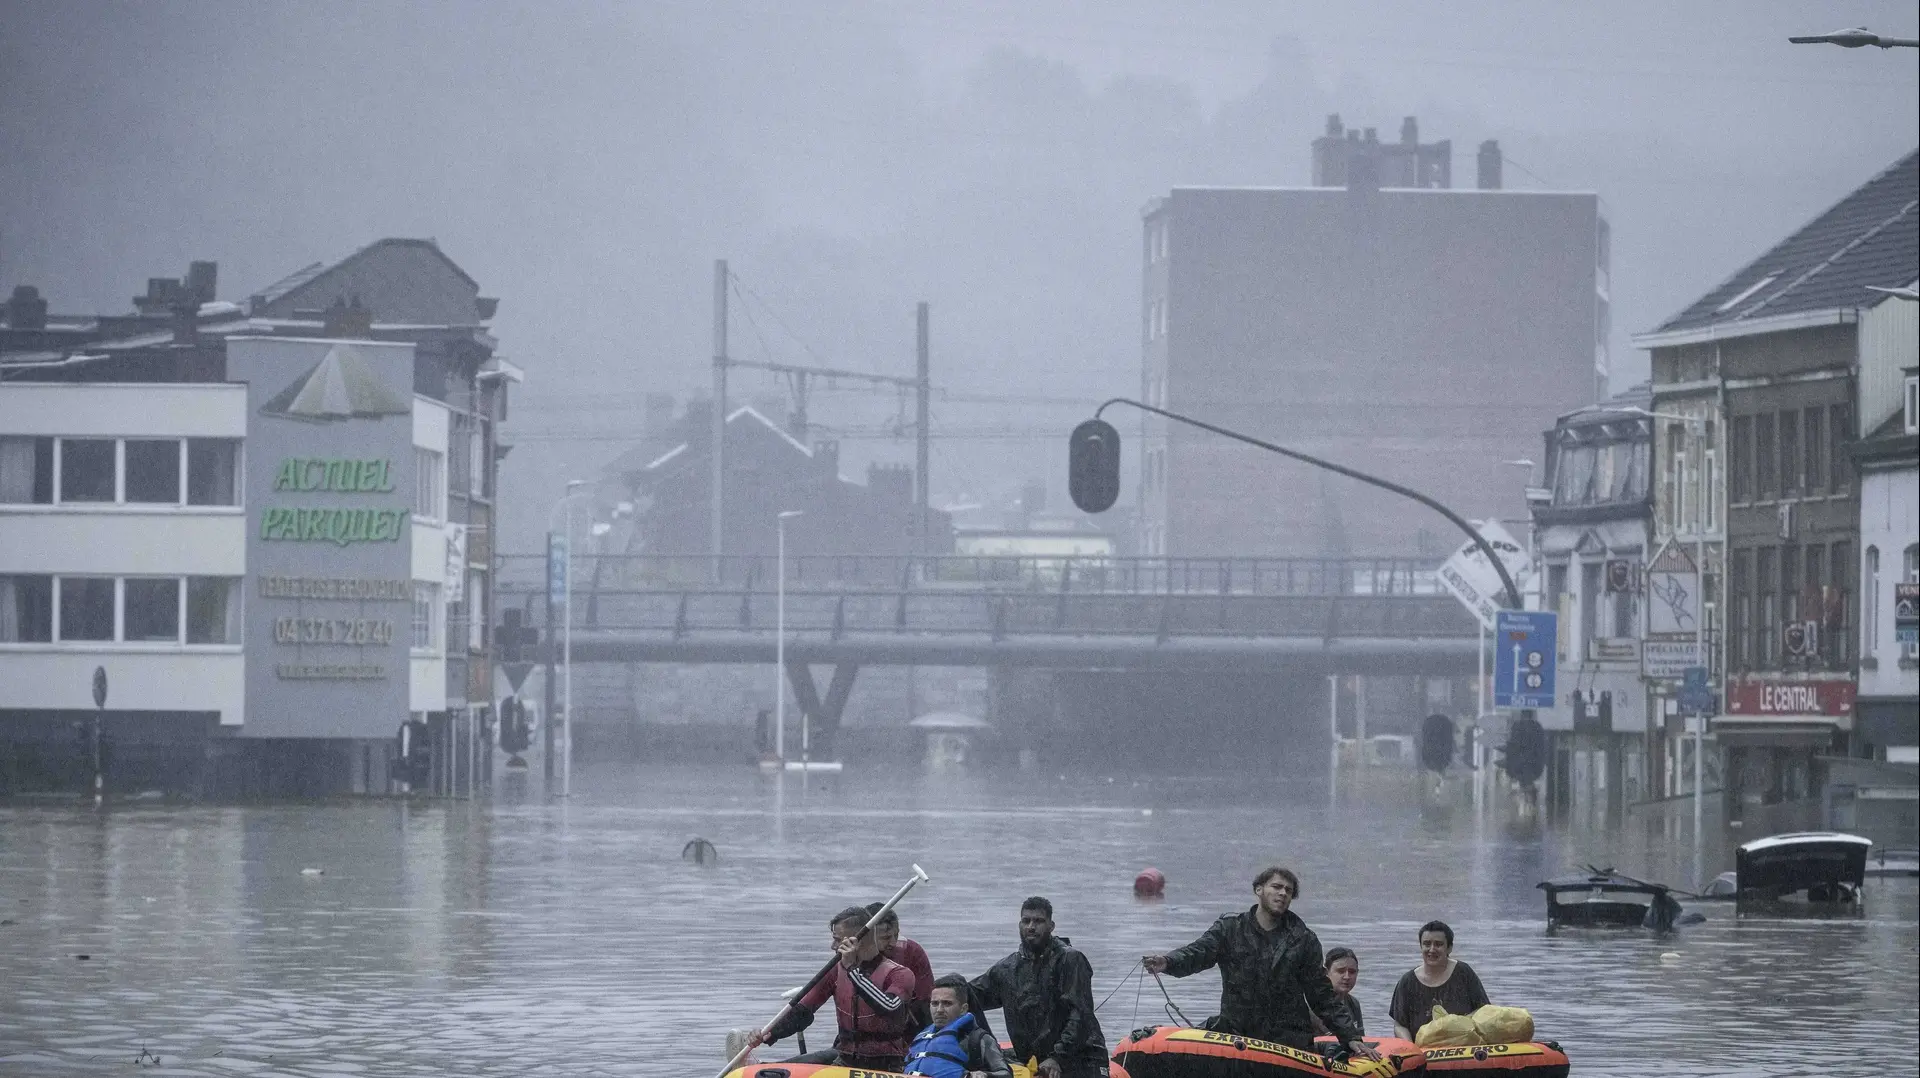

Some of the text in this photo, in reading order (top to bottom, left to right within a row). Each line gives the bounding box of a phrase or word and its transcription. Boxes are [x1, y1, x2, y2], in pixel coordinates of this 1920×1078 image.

[275, 457, 396, 492] ACTUEL
[261, 508, 410, 547] PARQUET
[275, 617, 394, 644] 04 371 28 40
[1760, 687, 1820, 711] LE CENTRAL
[1203, 1031, 1319, 1064] EXPLORER PRO
[1470, 1044, 1509, 1055] PRO
[1332, 1061, 1348, 1072] 200
